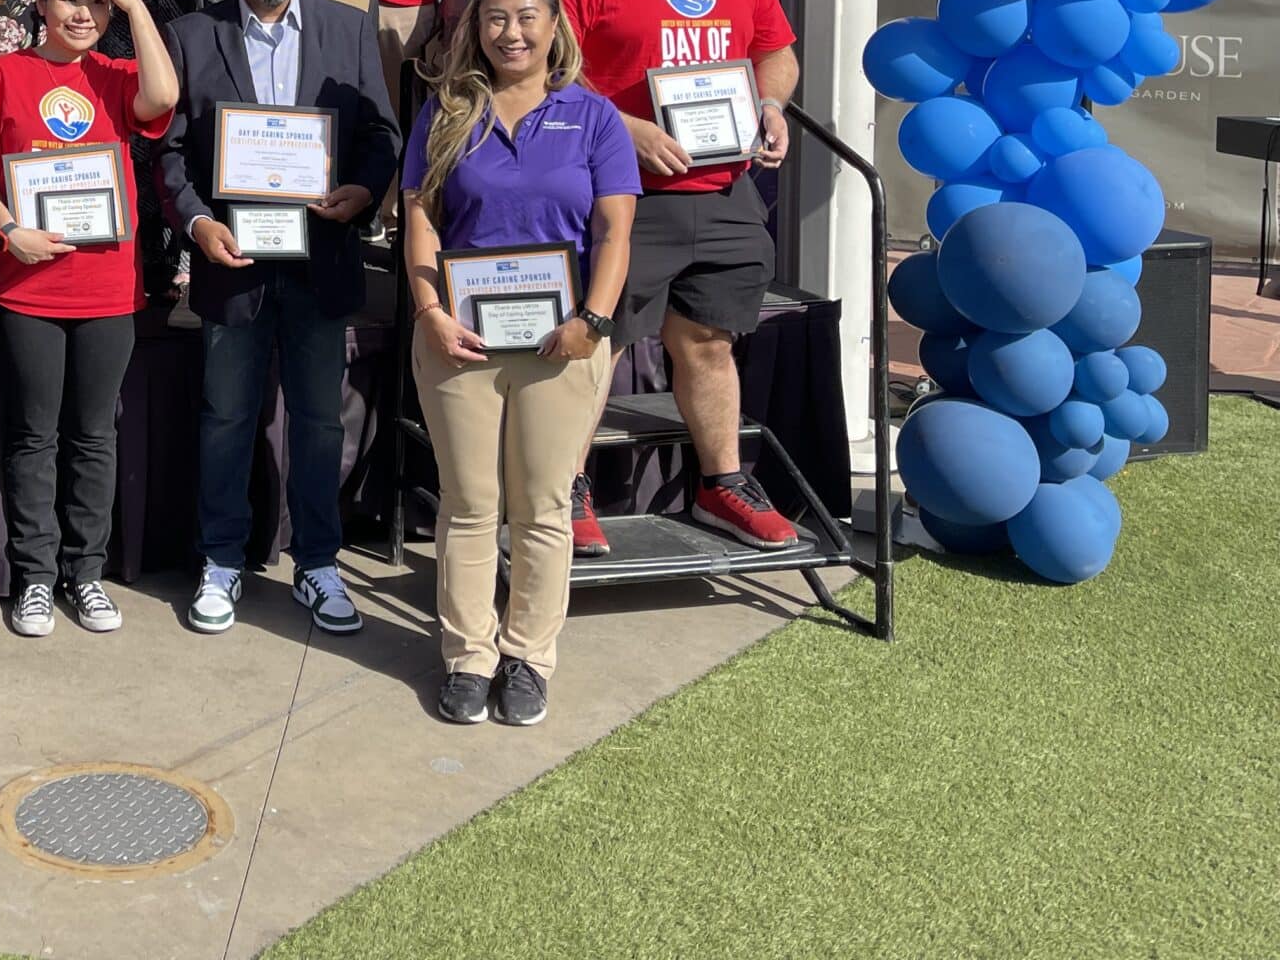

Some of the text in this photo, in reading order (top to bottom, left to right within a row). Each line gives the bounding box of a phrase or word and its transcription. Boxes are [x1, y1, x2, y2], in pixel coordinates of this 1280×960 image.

[661, 27, 732, 60] DAY OF
[1131, 89, 1201, 102] GARDEN
[238, 129, 313, 141] DAY OF CARING SPONSOR
[466, 271, 551, 286] DAY OF CARING SPONSOR
